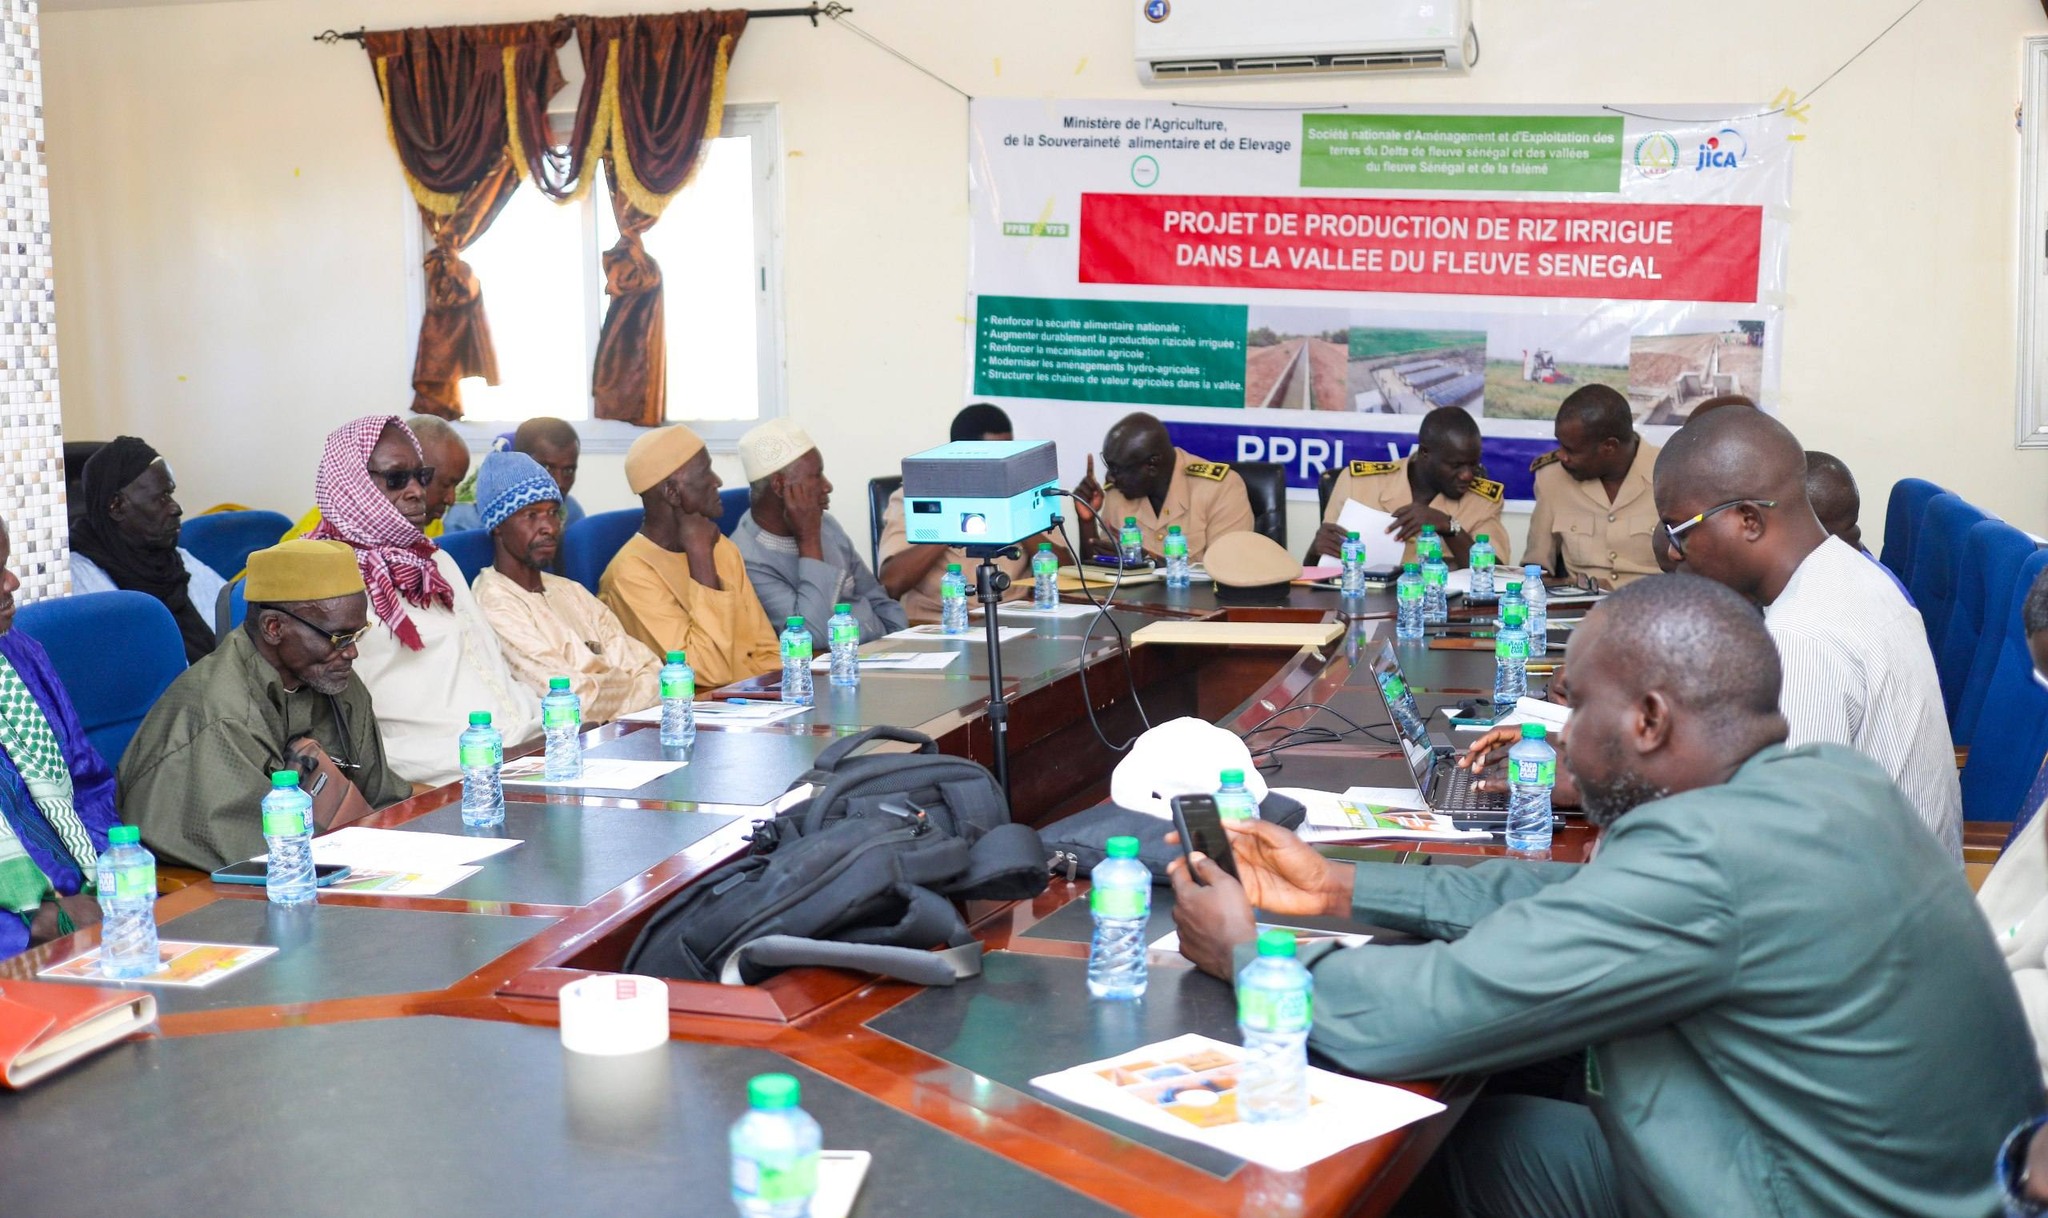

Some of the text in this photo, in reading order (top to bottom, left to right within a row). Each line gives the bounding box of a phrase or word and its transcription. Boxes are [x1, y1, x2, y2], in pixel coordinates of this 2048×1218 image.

[1063, 116, 1228, 133] Ministère de l'Agriculture,
[1003, 134, 1292, 154] de la Souveraineté alimentaire et de Elevage
[1308, 128, 1615, 145] Société nationale d'Aménagement et d'Exploitation des
[1329, 145, 1360, 156] terres
[1363, 145, 1378, 156] du
[1380, 145, 1409, 156] Delta
[1411, 146, 1425, 157] de
[1428, 145, 1463, 157] fleuve
[1512, 147, 1523, 158] et
[1525, 148, 1546, 159] des
[1549, 147, 1590, 159] vallées
[1366, 161, 1380, 172] du
[1383, 161, 1417, 172] fleuve
[1419, 161, 1465, 175] Sénégal
[1467, 163, 1479, 173] et
[1481, 163, 1495, 174] de
[1498, 163, 1509, 174] la
[1163, 210, 1673, 244] PROJET DE PRODUCTION DE RIZ IRRIGUE
[1176, 244, 1662, 279] DANS LA VALLEE DU FLEUVE SENEGAL
[990, 315, 1034, 327] Renforcer
[1036, 317, 1044, 327] la
[1083, 319, 1134, 331] alimentaire
[1136, 322, 1180, 333] nationale
[990, 329, 1039, 341] Augmenter
[1041, 331, 1096, 343] durablement
[1098, 334, 1107, 344] la
[1109, 334, 1160, 346] production
[1162, 337, 1196, 347] rizicole
[990, 342, 1034, 353] Renforcer
[1036, 344, 1044, 354] la
[1107, 349, 1145, 360] agricole
[989, 356, 1039, 367] Moderniser
[1042, 358, 1054, 368] les
[1127, 361, 1201, 375] hydro-agricoles
[988, 369, 1034, 380] Structurer
[1036, 371, 1049, 381] les
[1087, 375, 1099, 384] de
[1101, 376, 1130, 385] valeur
[1132, 378, 1174, 389] agricoles
[1177, 379, 1201, 389] dans
[1203, 379, 1211, 389] la
[1236, 434, 1344, 479] PPRI
